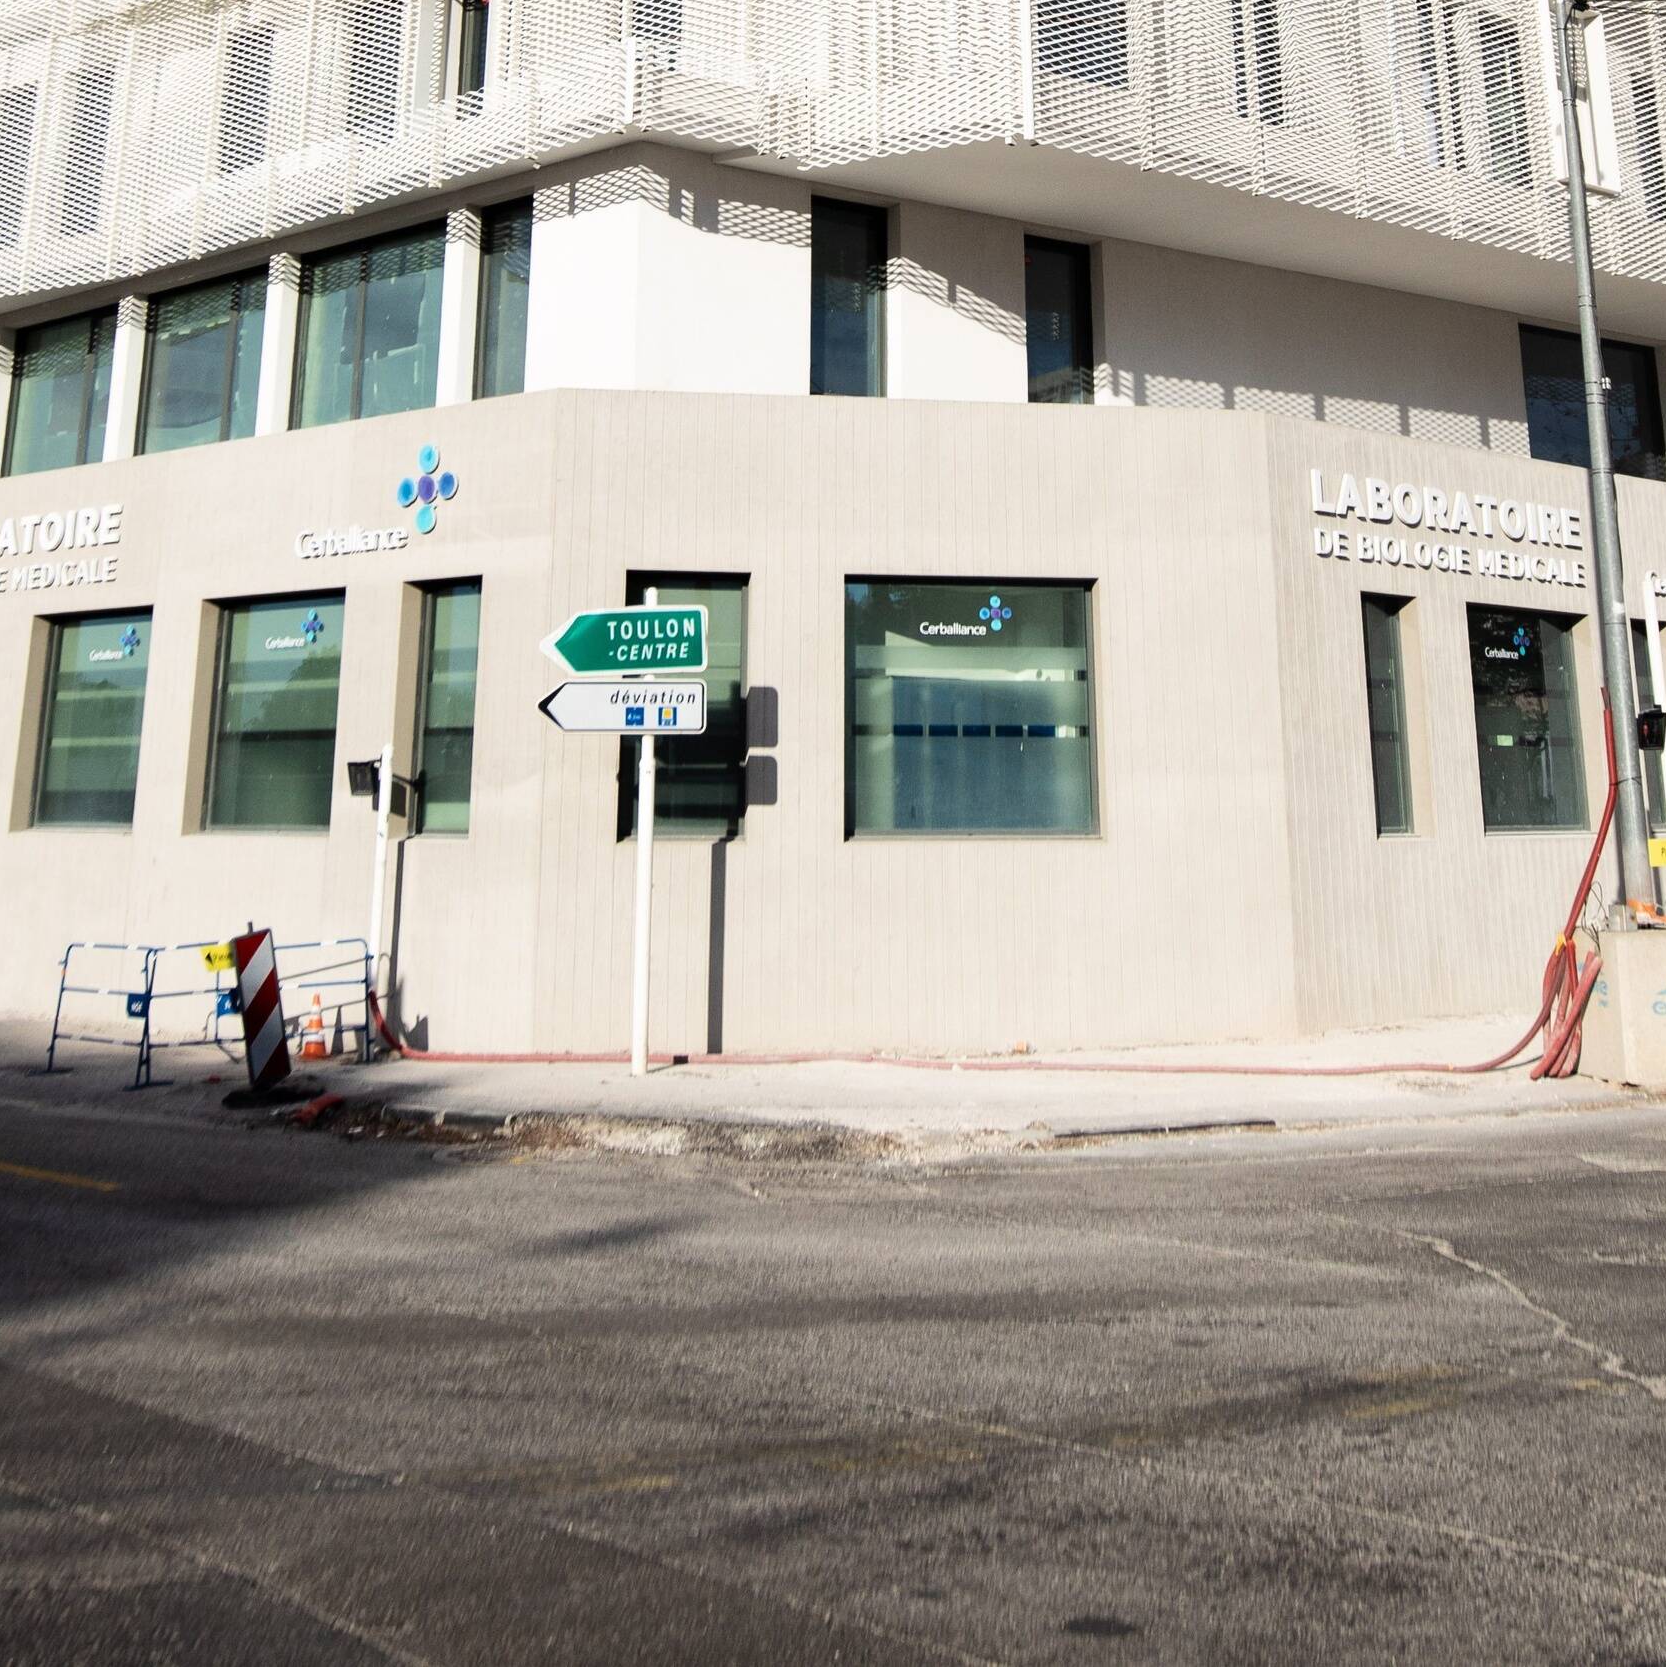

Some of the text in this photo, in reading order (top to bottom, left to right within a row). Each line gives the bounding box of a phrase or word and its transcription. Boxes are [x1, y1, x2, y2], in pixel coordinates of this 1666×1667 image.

[1310, 468, 1583, 550] LABORATOIRE
[294, 525, 409, 559] Cerballiance
[1314, 527, 1350, 561] DE
[1356, 533, 1472, 575] BIOLOGIE
[607, 618, 695, 640] TOULON
[919, 621, 987, 636] Cerballiance
[1484, 646, 1520, 660] Cerballiance
[610, 689, 696, 705] déviation
